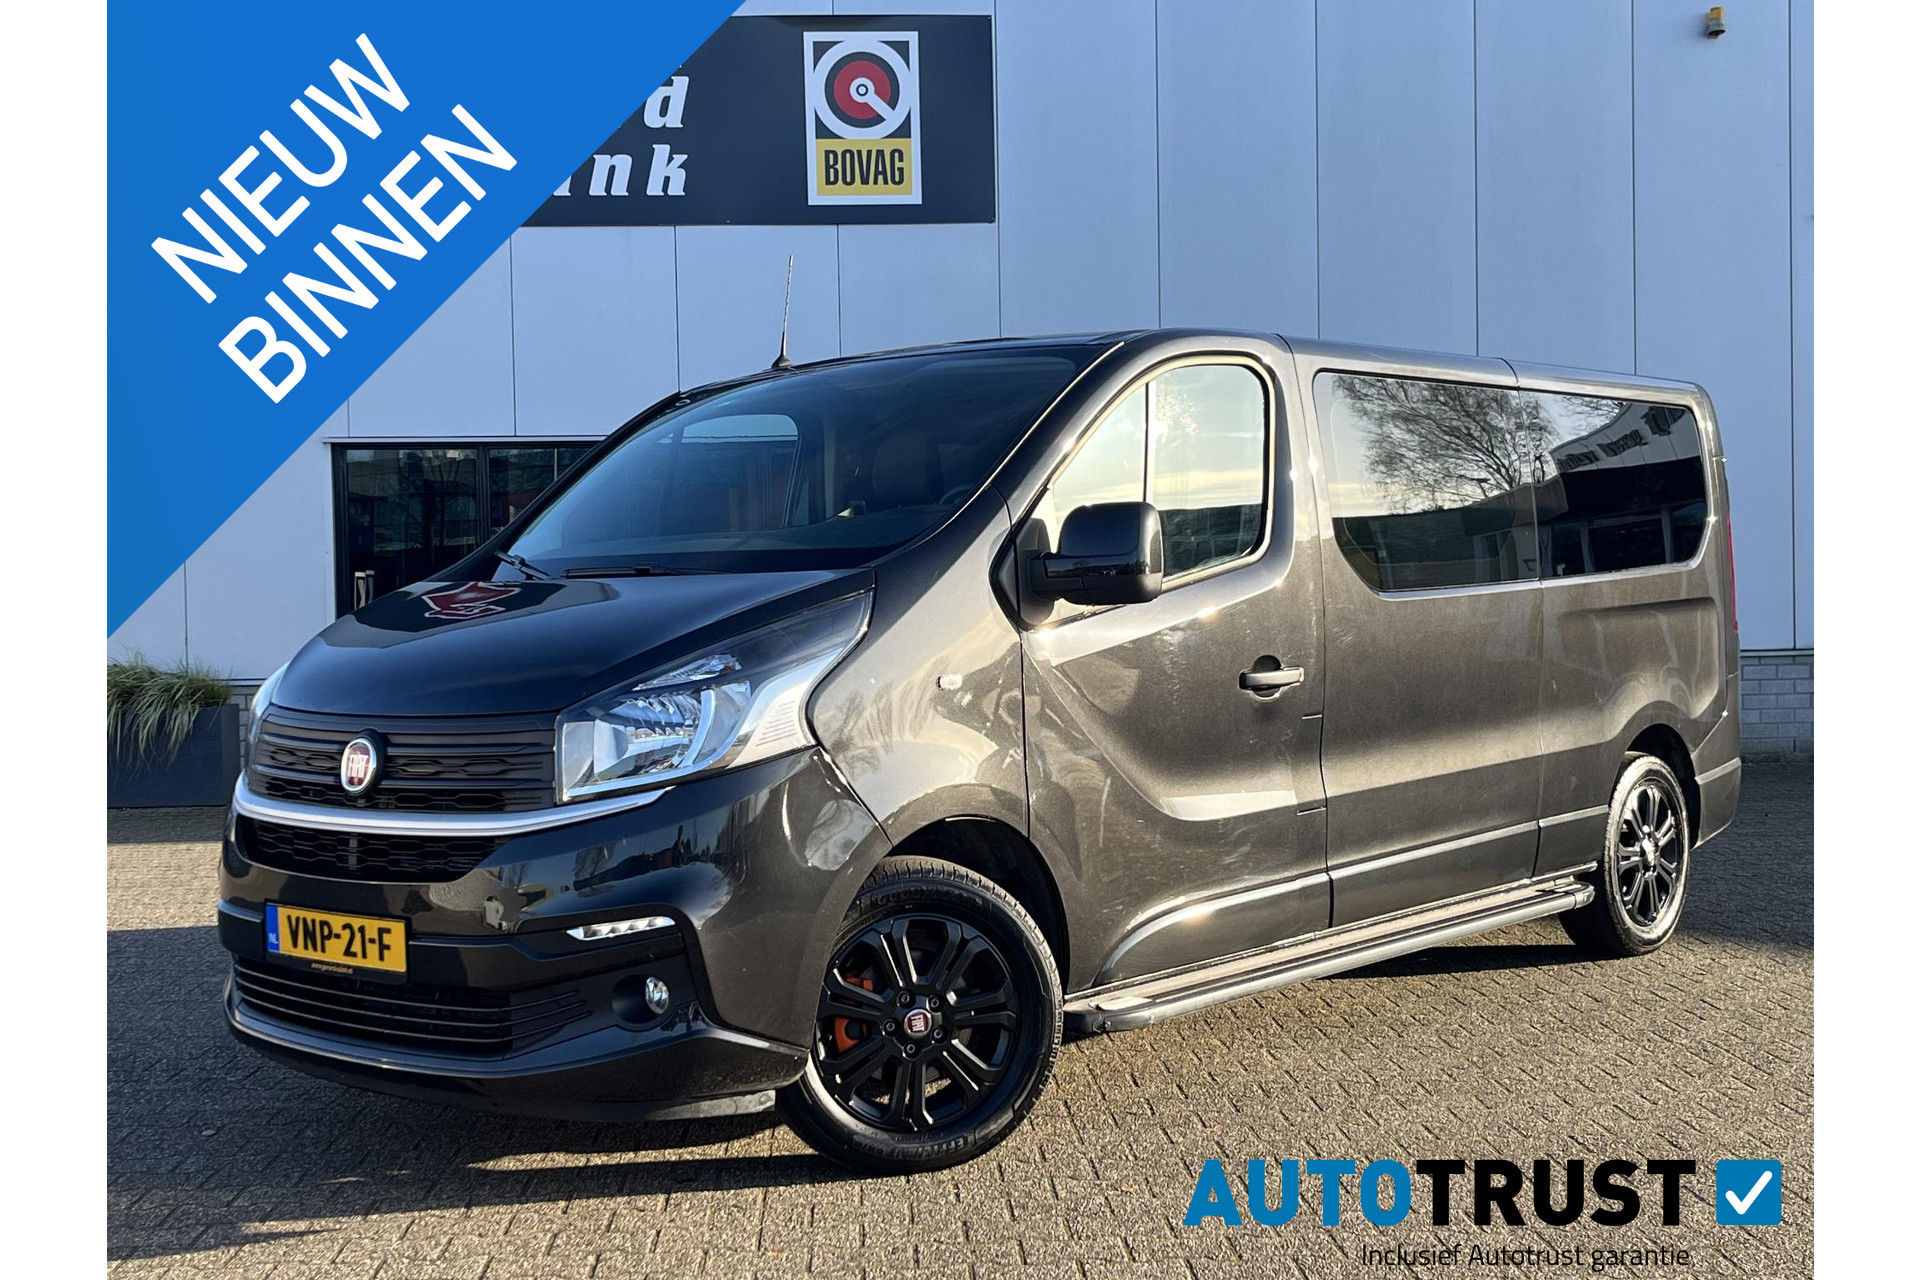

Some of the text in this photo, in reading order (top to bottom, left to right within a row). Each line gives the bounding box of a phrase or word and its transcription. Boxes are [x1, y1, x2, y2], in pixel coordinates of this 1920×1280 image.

[618, 76, 690, 128] d
[824, 149, 904, 186] BOVAG
[287, 914, 392, 962] VNP-21-F
